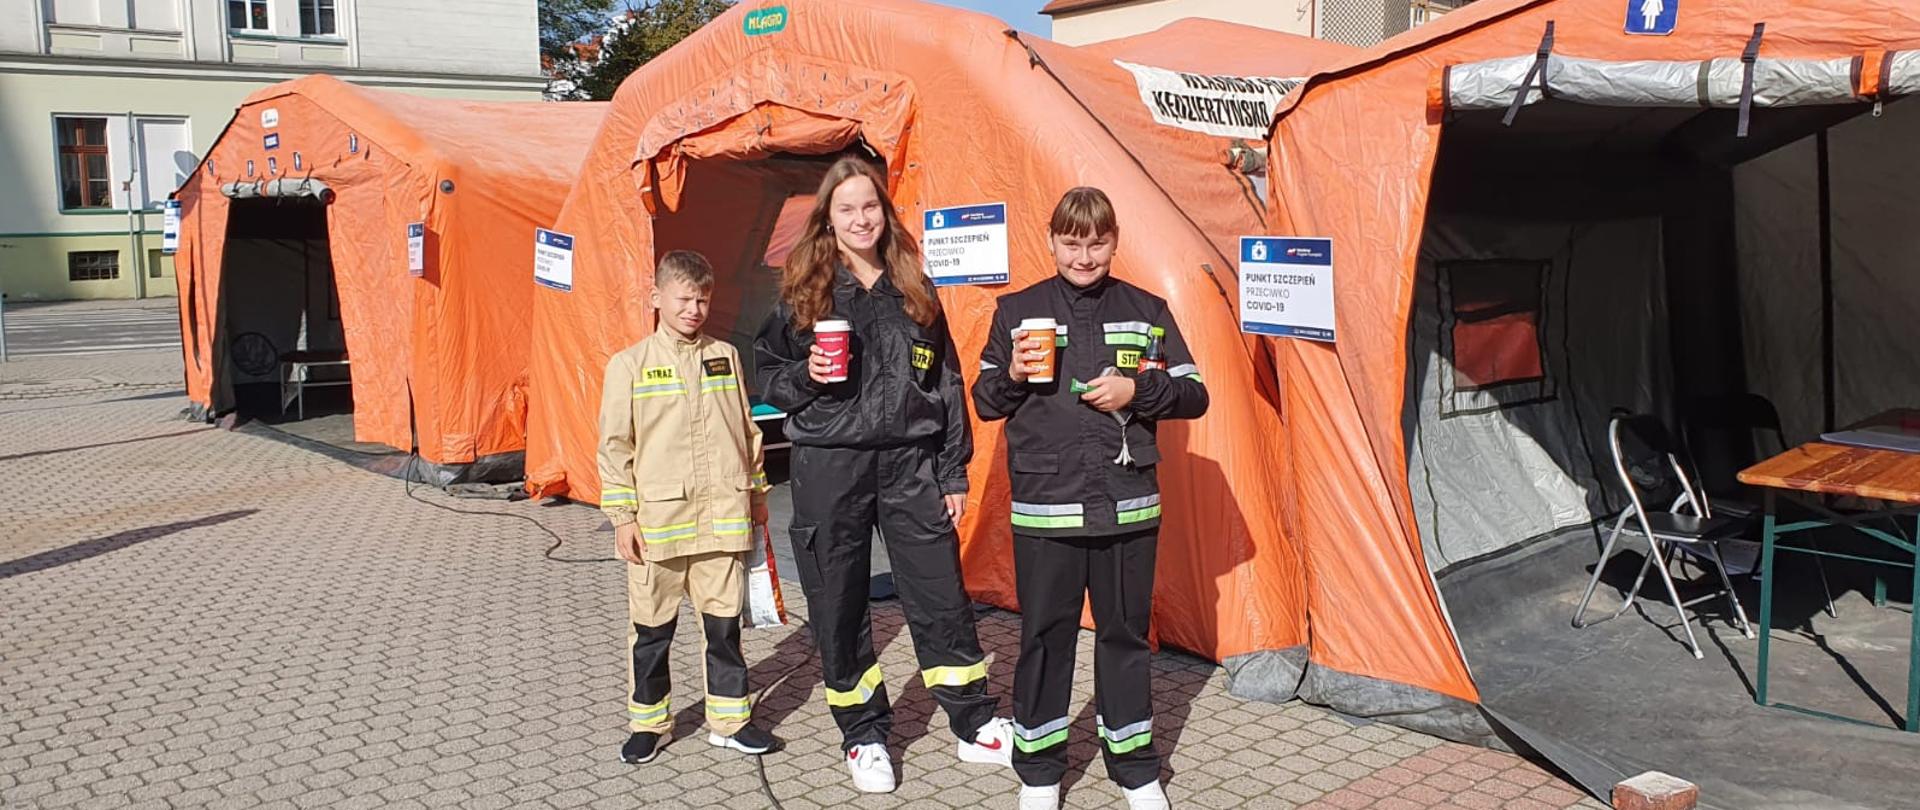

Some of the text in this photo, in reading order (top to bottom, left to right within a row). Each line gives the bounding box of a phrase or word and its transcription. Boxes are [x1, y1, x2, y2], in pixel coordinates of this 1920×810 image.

[1246, 273, 1316, 286] PUNKT SZCZEPIEŃ
[1246, 287, 1290, 299] PRZECIWKO
[1246, 301, 1285, 312] COVID-19
